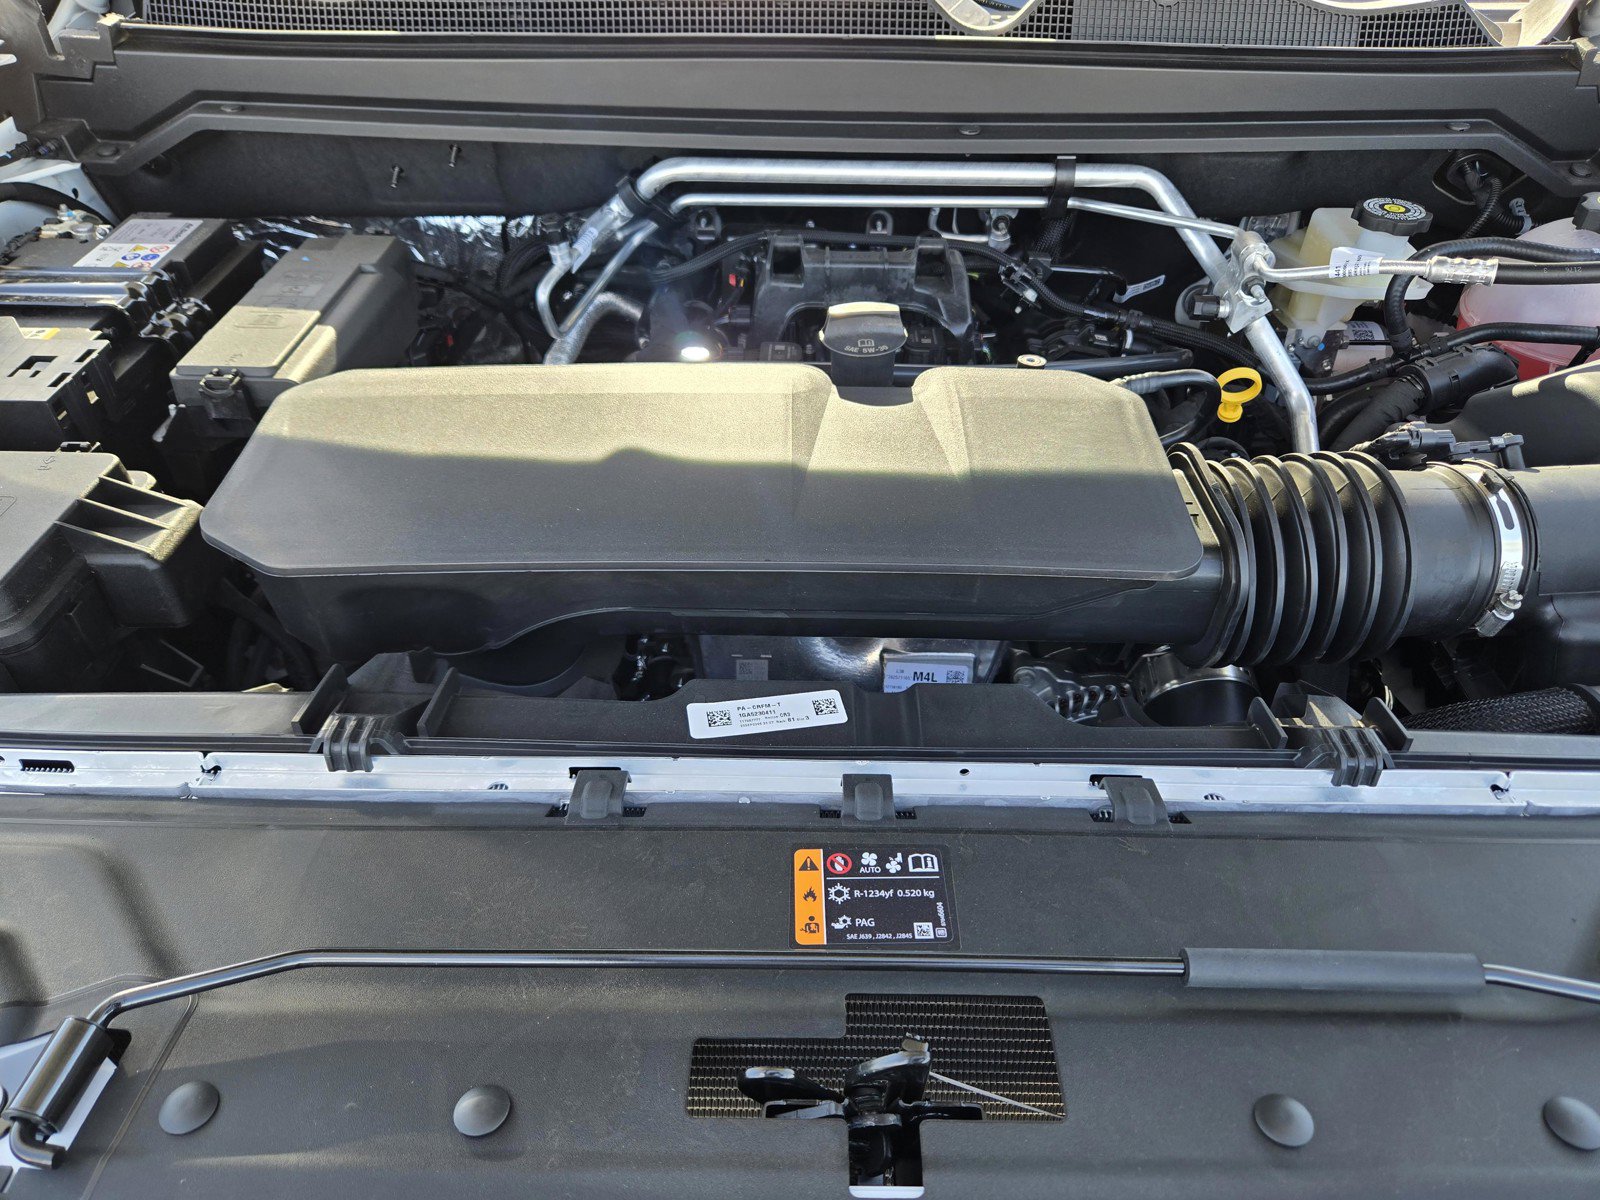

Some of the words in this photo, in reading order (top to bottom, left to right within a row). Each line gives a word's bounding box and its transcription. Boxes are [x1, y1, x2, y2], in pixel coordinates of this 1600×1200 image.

[912, 671, 938, 683] M4L
[859, 866, 882, 874] AUTO
[853, 888, 894, 899] R-1234yf
[896, 889, 922, 898] 0.520
[922, 888, 935, 899] kg
[855, 918, 876, 927] PAG
